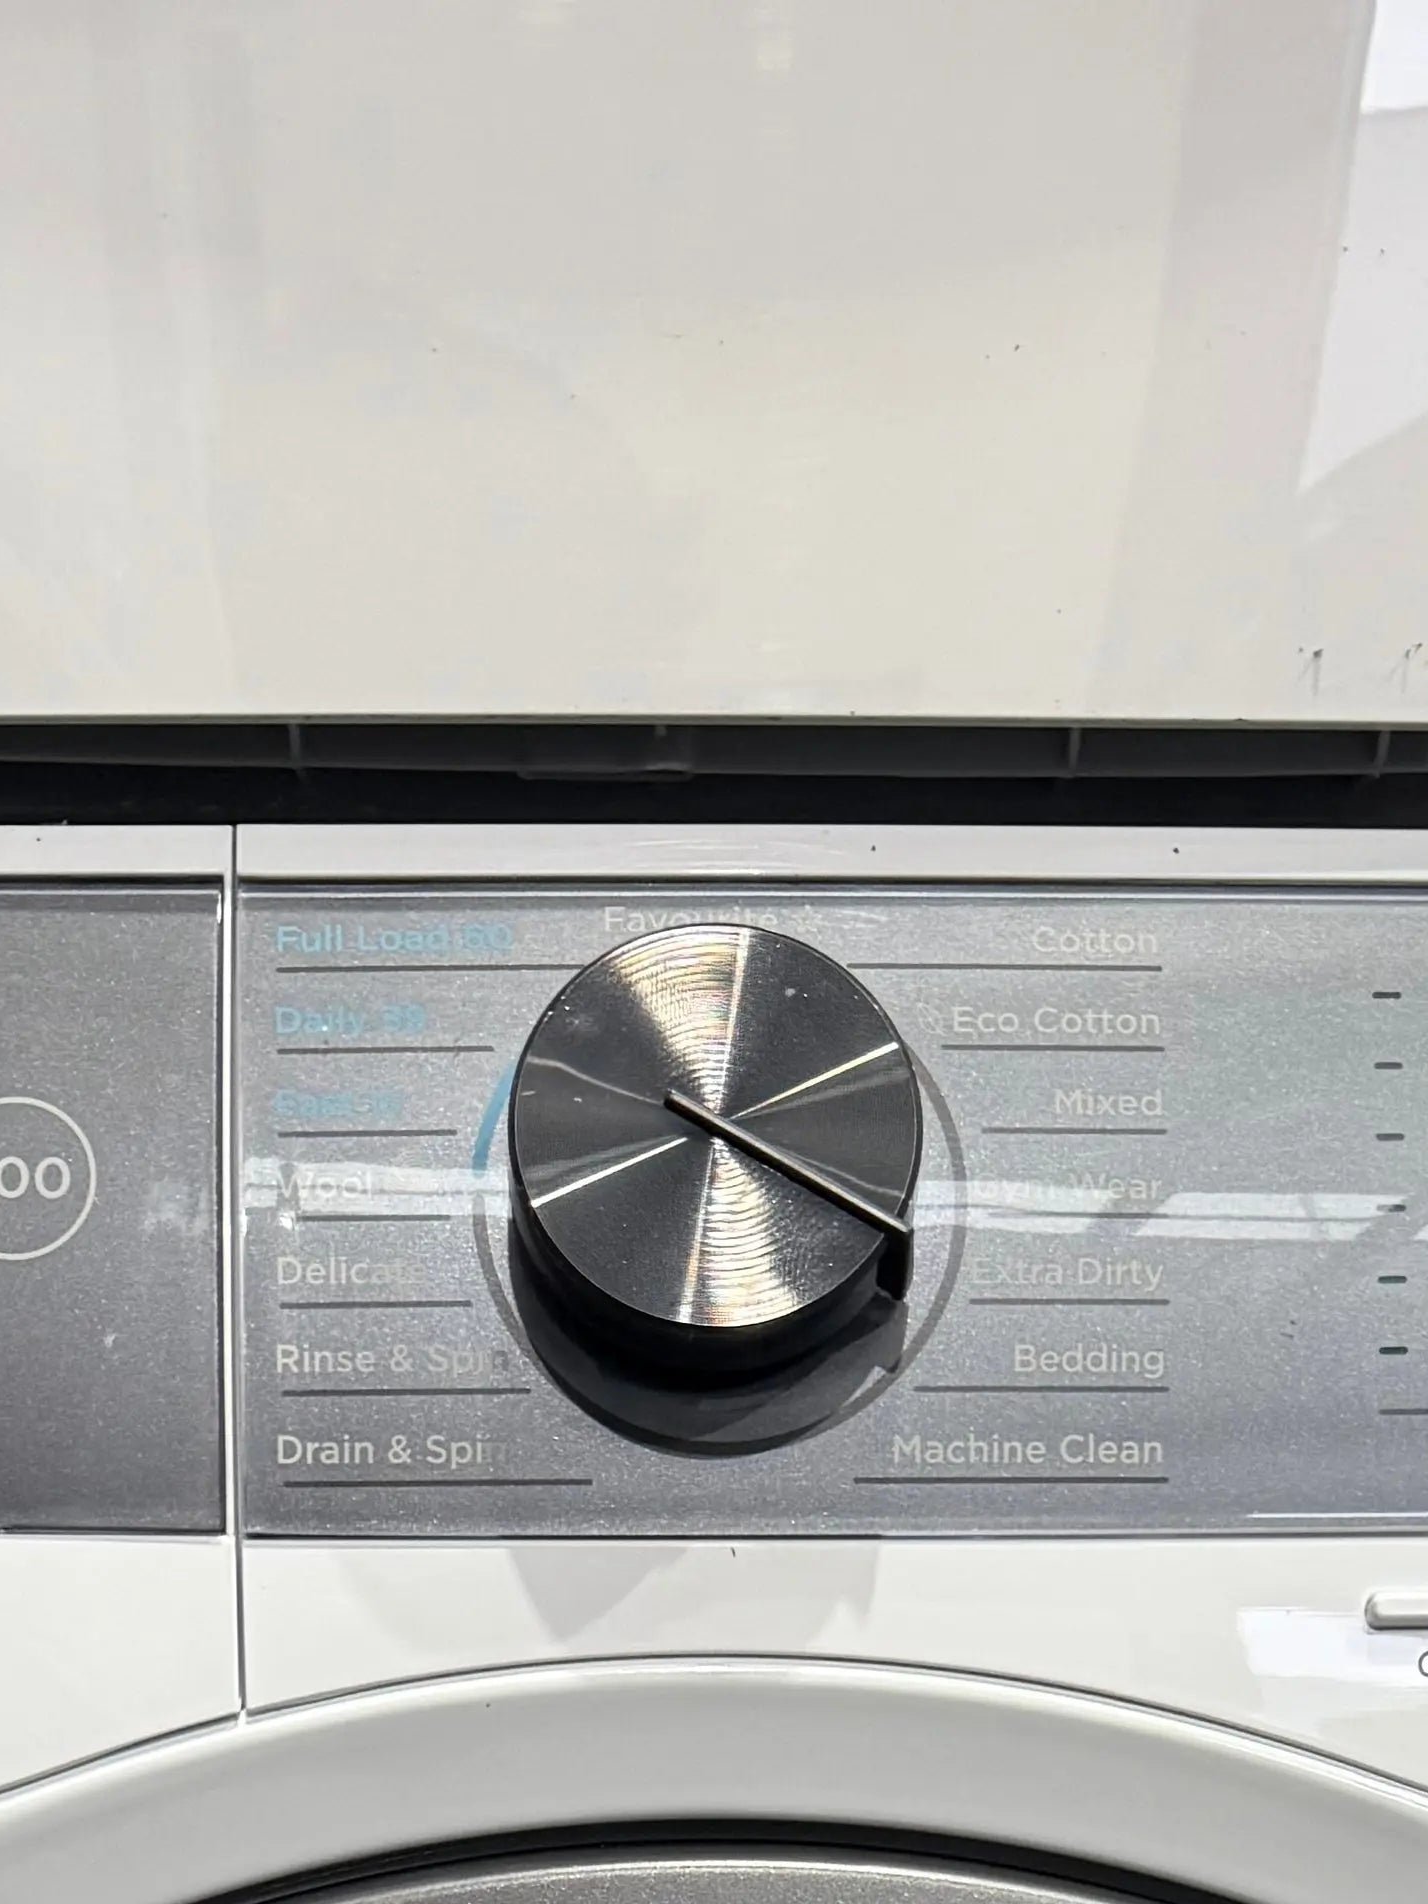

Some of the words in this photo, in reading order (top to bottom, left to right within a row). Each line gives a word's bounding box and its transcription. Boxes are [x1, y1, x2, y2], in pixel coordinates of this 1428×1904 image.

[276, 924, 344, 953] Full
[357, 923, 449, 952] Load
[1031, 926, 1160, 955] Cotton
[274, 1004, 366, 1037] Daily
[952, 1006, 1019, 1034] Eco
[1033, 1006, 1162, 1035] Cotton
[1053, 1088, 1163, 1117] Mixed
[276, 1169, 372, 1200] Wool
[1069, 1172, 1163, 1200] Wear
[276, 1255, 426, 1285] Delicate
[974, 1256, 1064, 1286] Extra
[1078, 1256, 1164, 1292] Dirty
[276, 1344, 375, 1373] Rinse
[389, 1344, 415, 1373] &
[428, 1343, 509, 1382] Spin
[1013, 1343, 1165, 1381] Bedding
[276, 1433, 375, 1466] Drain
[388, 1436, 413, 1466] &
[426, 1434, 507, 1473] Spin
[893, 1432, 1047, 1466] Machine
[1060, 1433, 1164, 1466] Clean
